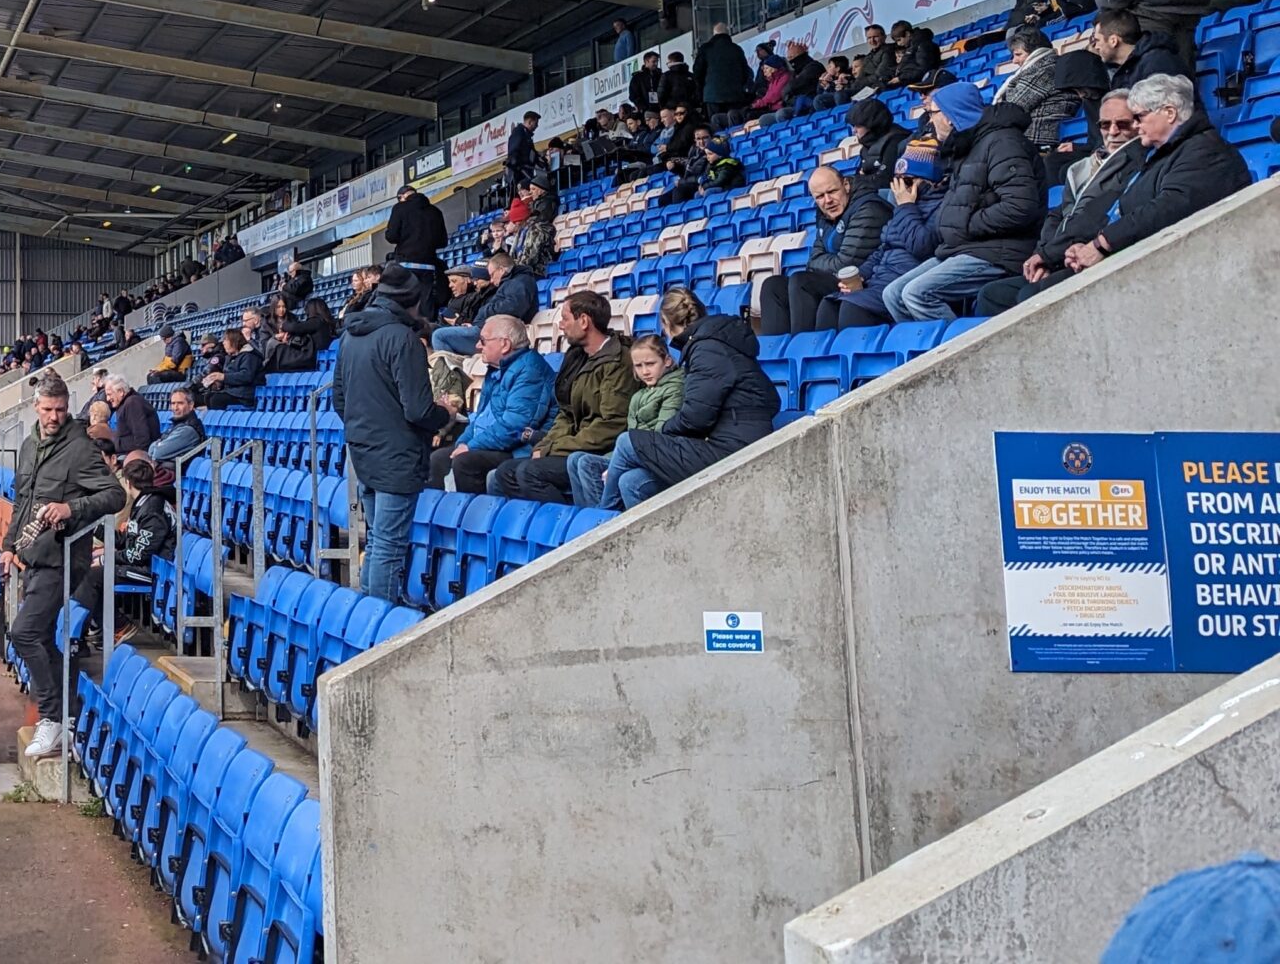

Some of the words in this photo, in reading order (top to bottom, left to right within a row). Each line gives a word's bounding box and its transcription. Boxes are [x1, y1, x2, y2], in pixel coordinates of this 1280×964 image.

[593, 70, 621, 97] Darwin
[1182, 461, 1270, 484] PLEASE
[1019, 486, 1046, 495] ENJOY
[1046, 486, 1063, 495] THE
[1063, 486, 1091, 495] MATCH
[1186, 492, 1255, 514] FROM
[1018, 503, 1143, 526] TOGETHER
[1193, 553, 1227, 575] OR
[1231, 553, 1280, 575] ANT
[712, 632, 734, 640] Please
[1198, 614, 1247, 637] OUR
[1252, 614, 1280, 637] ST
[728, 642, 756, 650] covering
